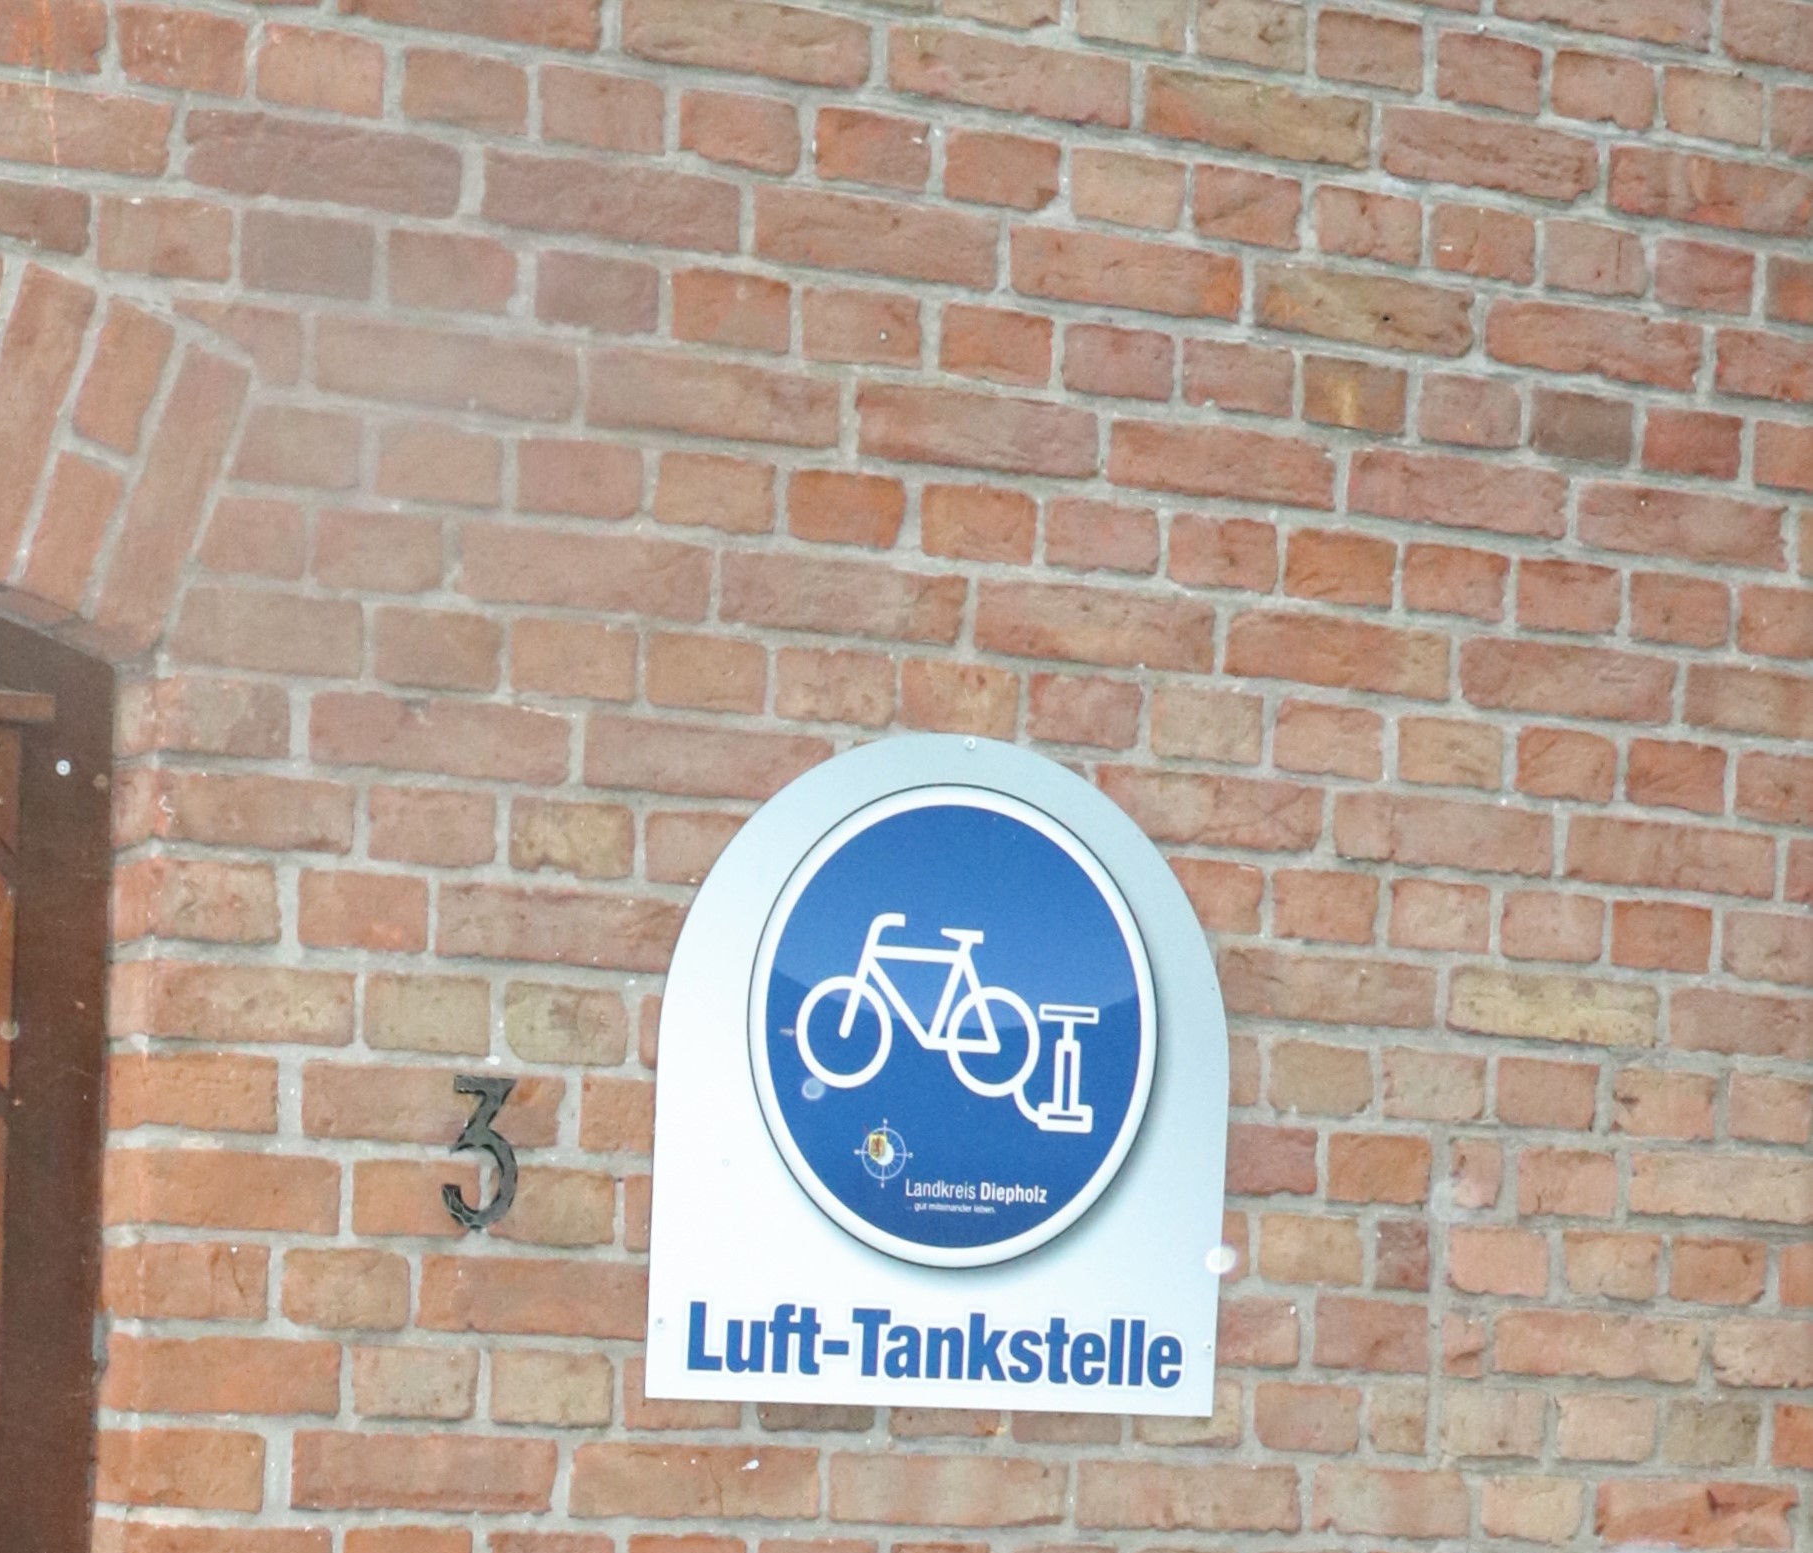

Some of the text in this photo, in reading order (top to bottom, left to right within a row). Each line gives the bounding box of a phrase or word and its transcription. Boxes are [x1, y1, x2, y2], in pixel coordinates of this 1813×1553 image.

[442, 1075, 518, 1233] 3
[905, 1178, 1048, 1205] Landkreis Diepholz
[687, 1301, 1182, 1388] Luft-Tankstelle
